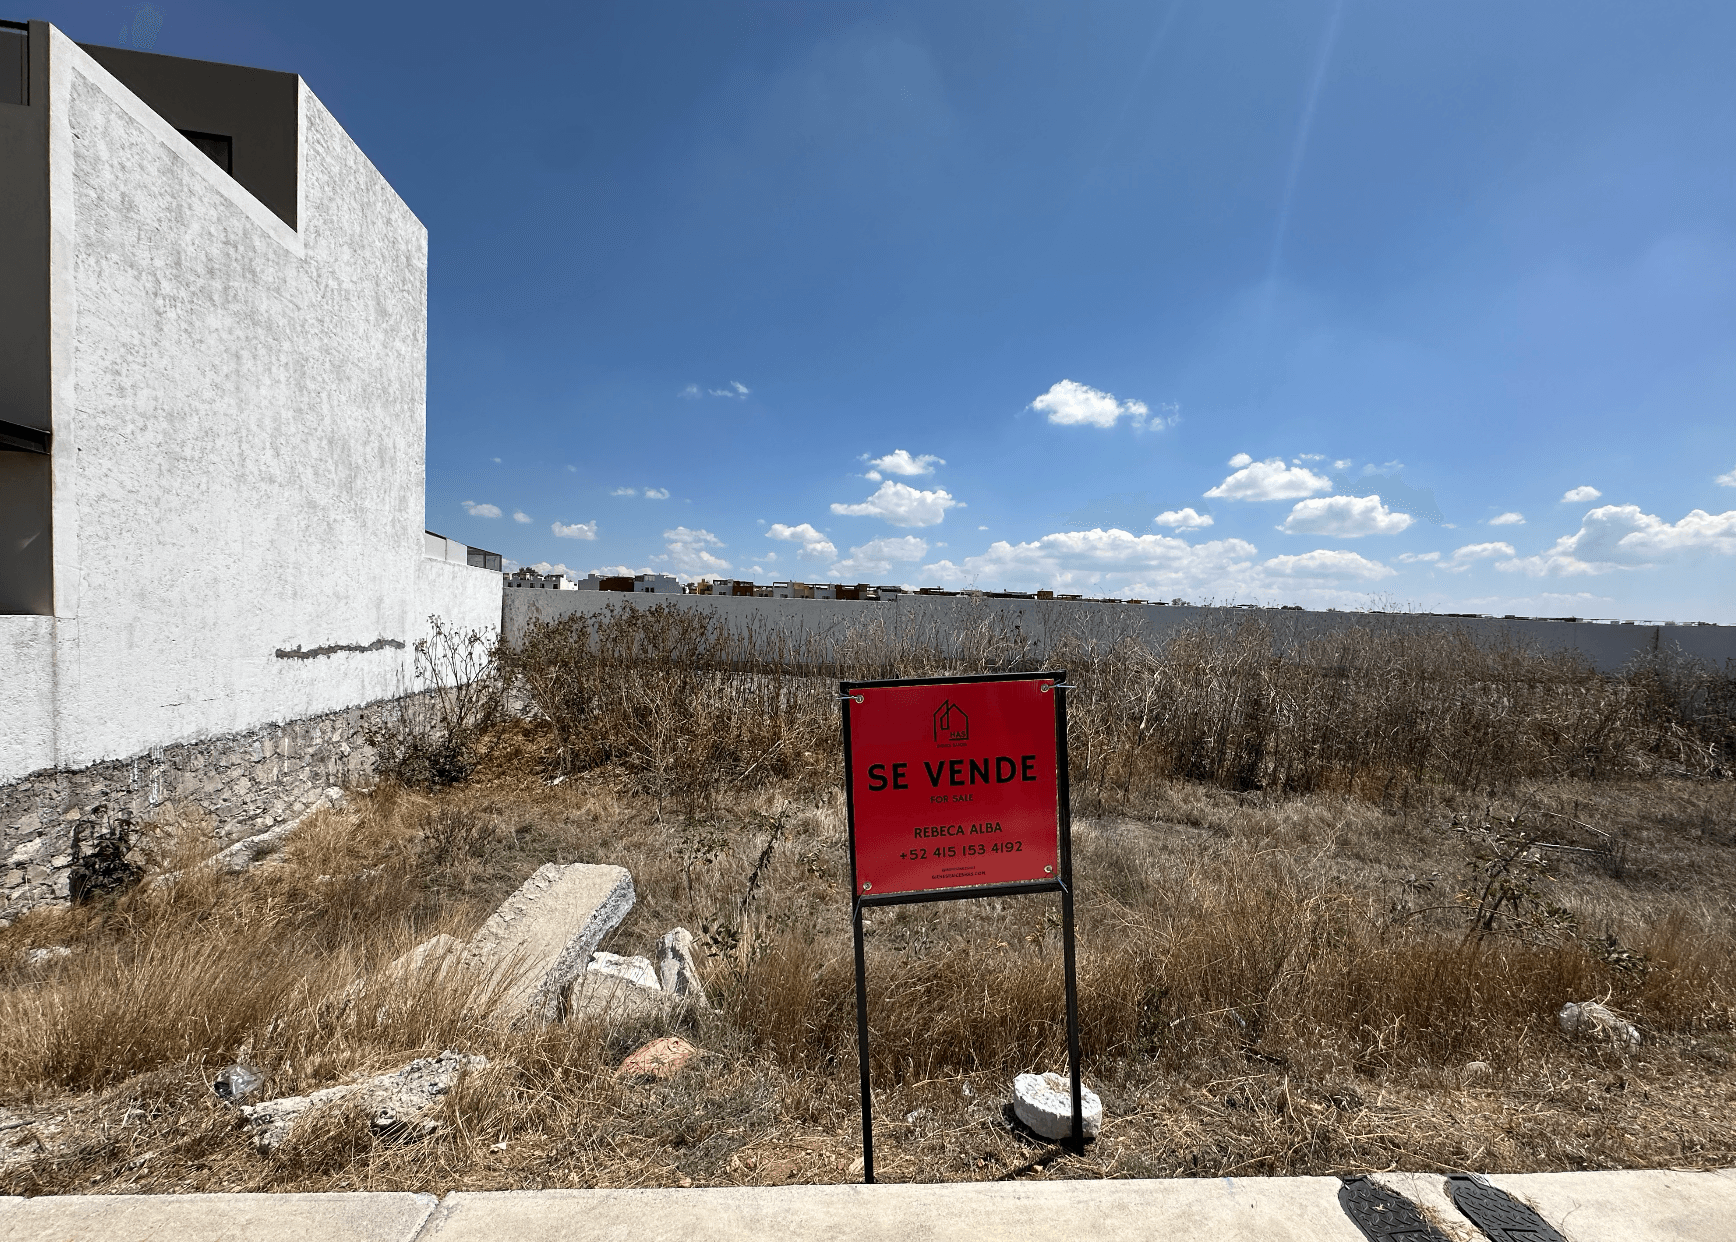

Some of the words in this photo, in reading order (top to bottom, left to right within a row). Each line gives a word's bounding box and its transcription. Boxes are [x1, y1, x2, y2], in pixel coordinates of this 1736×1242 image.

[868, 763, 909, 791] SE
[923, 754, 1037, 788] VENDE
[930, 795, 949, 804] FOR
[952, 794, 973, 802] SALE
[914, 825, 965, 839] REBECA
[970, 822, 1002, 835] ALBA
[899, 848, 927, 860] +52
[933, 846, 956, 858] 415
[962, 844, 986, 856] 153
[991, 841, 1023, 854] 4192
